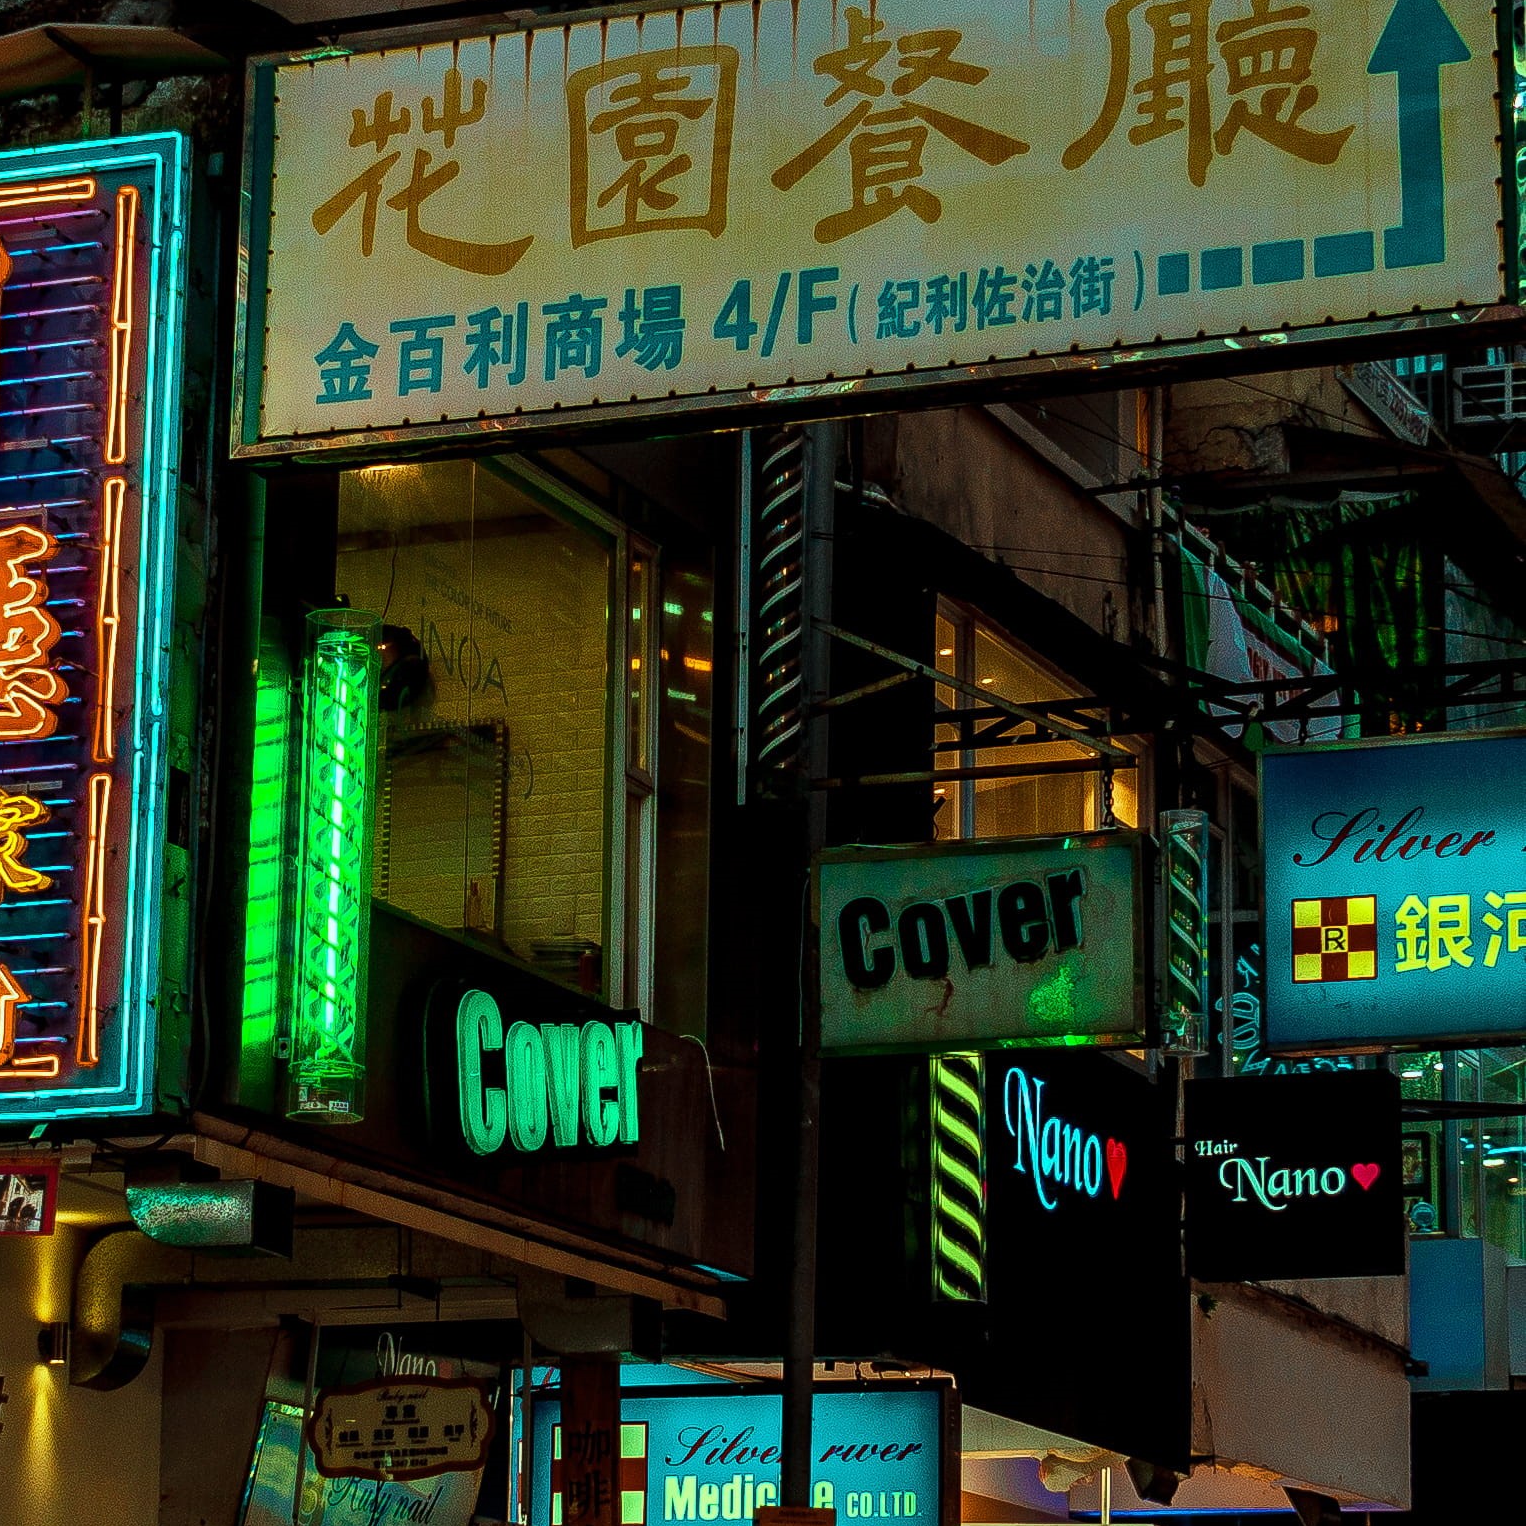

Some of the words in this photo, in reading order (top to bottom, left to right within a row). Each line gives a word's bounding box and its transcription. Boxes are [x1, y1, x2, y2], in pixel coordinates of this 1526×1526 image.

[313, 282, 688, 407] 金百利商場
[713, 265, 841, 359] 4/F
[1292, 804, 1496, 869] Silver
[839, 865, 1085, 991] Cover
[457, 989, 645, 1157] Cover
[1004, 1067, 1103, 1211] Nano
[1194, 1138, 1238, 1159] Hair
[1218, 1156, 1346, 1211] Nano
[818, 1438, 924, 1464] river
